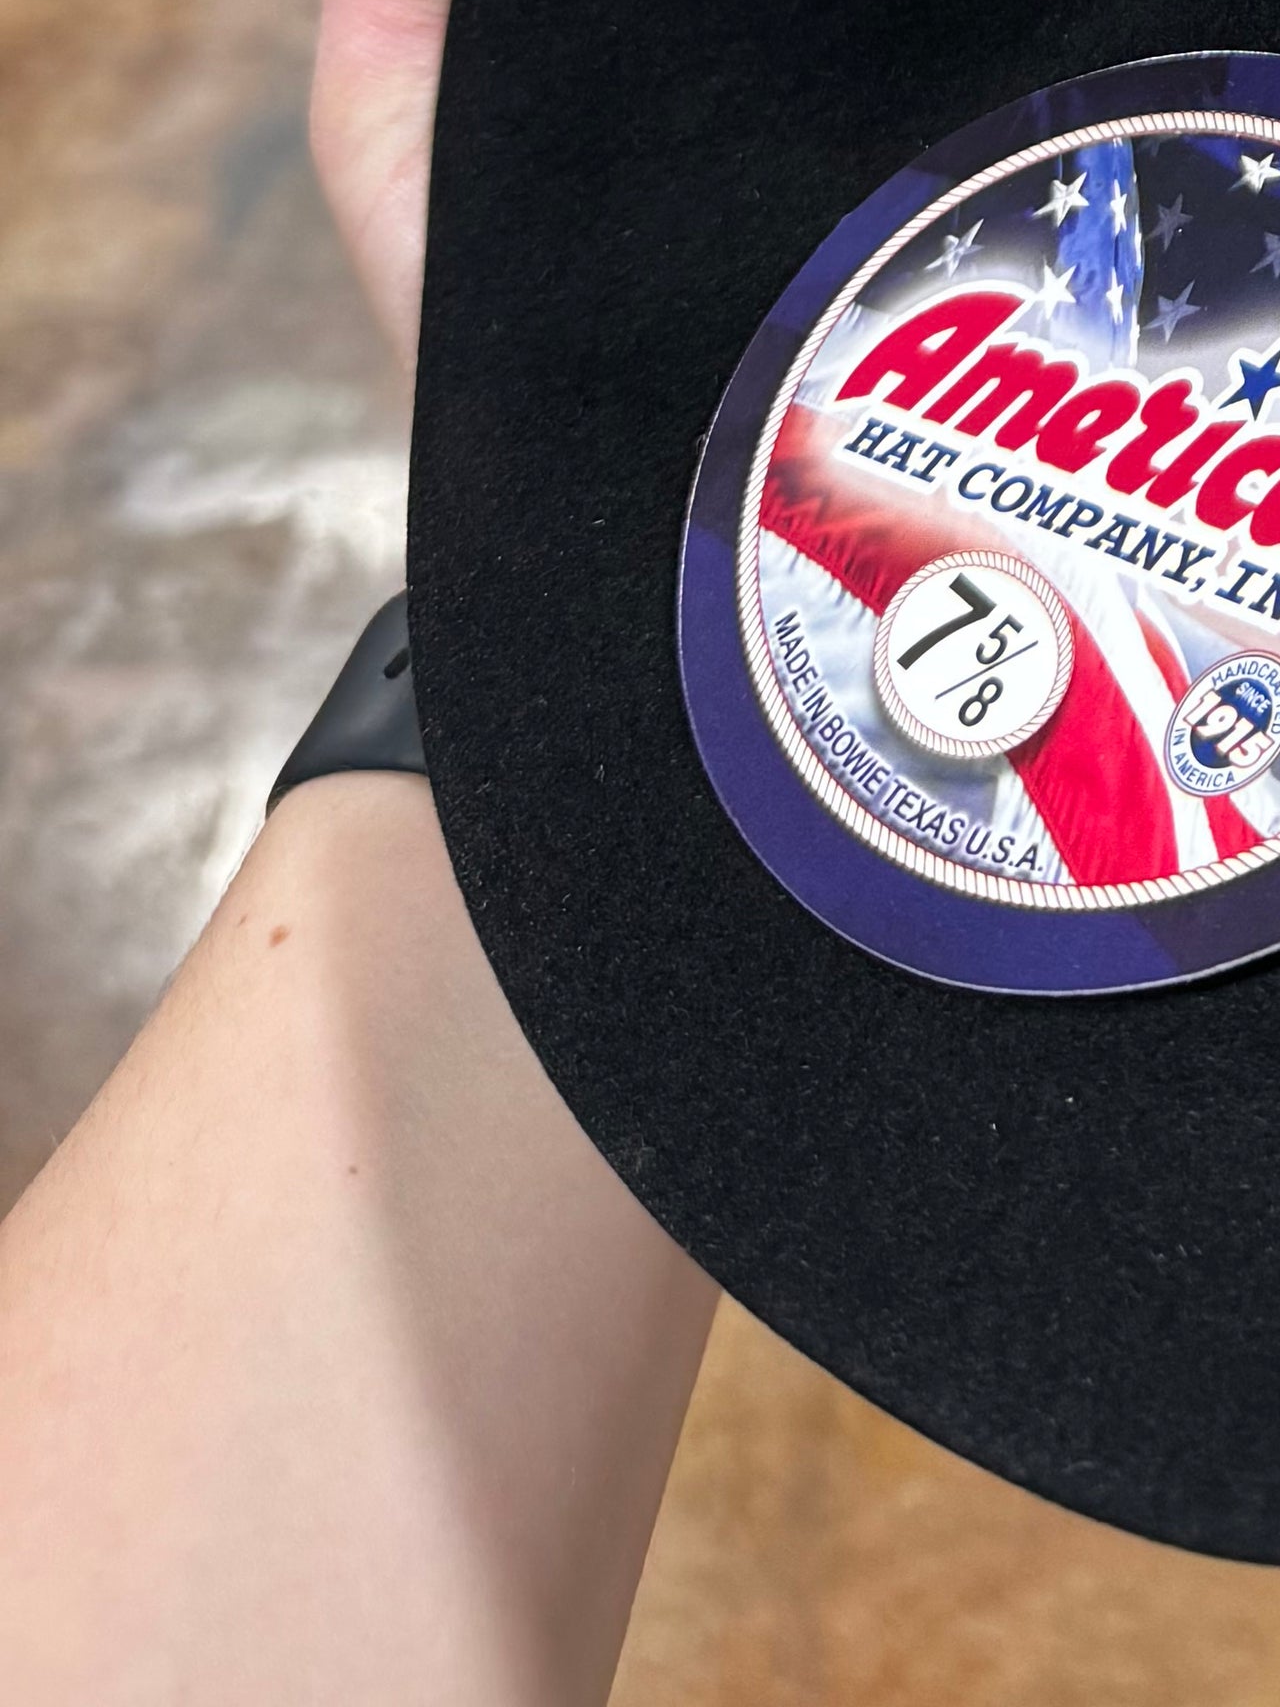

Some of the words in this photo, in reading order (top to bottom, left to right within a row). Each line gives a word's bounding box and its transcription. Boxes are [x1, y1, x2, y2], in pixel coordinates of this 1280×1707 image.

[843, 416, 960, 485] HAT
[957, 460, 1216, 593] COMPANY,
[896, 571, 998, 671] 7
[1172, 727, 1187, 747] IN
[1182, 688, 1276, 769] 1915
[1235, 681, 1272, 714] SINCE
[774, 609, 819, 695] MADE
[801, 685, 834, 727] IN
[818, 713, 891, 796] BOWIE
[881, 777, 967, 846] TEXAS
[965, 828, 1044, 872] U.S.A.
[1173, 752, 1236, 788] AMERICA
